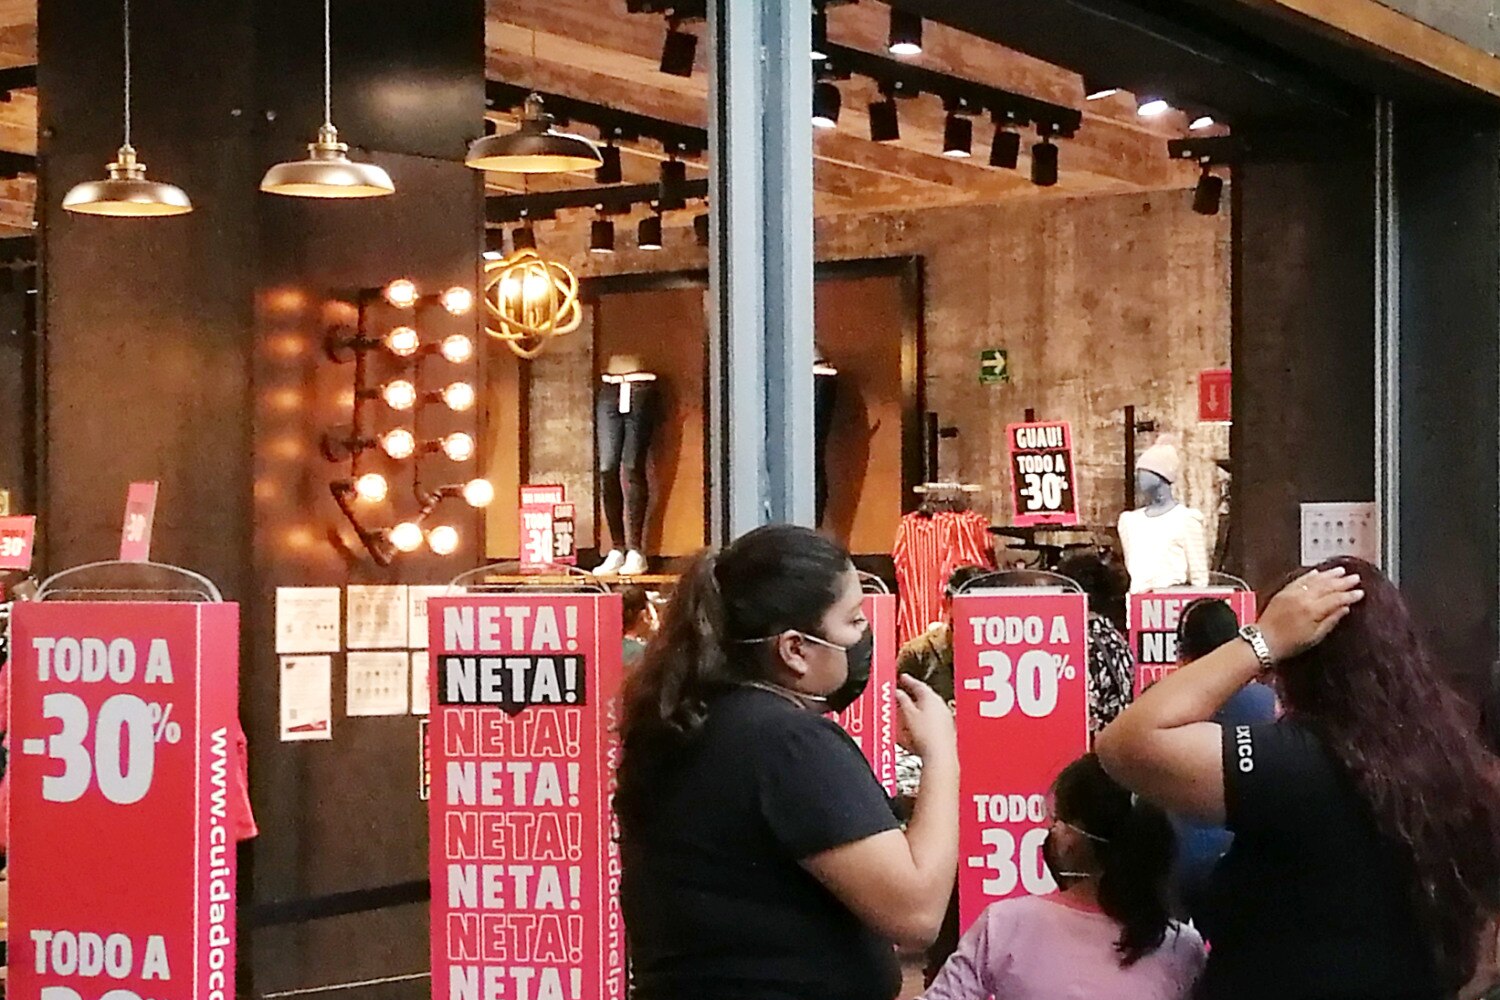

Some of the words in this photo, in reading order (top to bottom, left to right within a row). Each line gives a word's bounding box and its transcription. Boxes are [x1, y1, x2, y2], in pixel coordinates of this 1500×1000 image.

[1016, 427, 1063, 448] GUAU!
[1016, 454, 1054, 474] TODO
[1055, 454, 1066, 473] A
[1020, 473, 1069, 510] -30%
[444, 605, 578, 652] NETA!
[968, 615, 1044, 645] TODO
[1049, 615, 1071, 644] A
[32, 636, 137, 684] TODO
[144, 638, 174, 684] A
[446, 657, 578, 703] NETA!
[963, 649, 1076, 719] -30%
[22, 692, 181, 805] -30%
[444, 708, 581, 758] NETA!
[446, 761, 580, 807] NETA!
[973, 794, 1047, 824] TODO
[445, 811, 582, 861] NETA!
[967, 827, 1059, 896] -30
[447, 863, 581, 911] NETA!
[30, 929, 133, 979] TODO
[141, 935, 171, 981] A
[447, 912, 583, 964] NETA!
